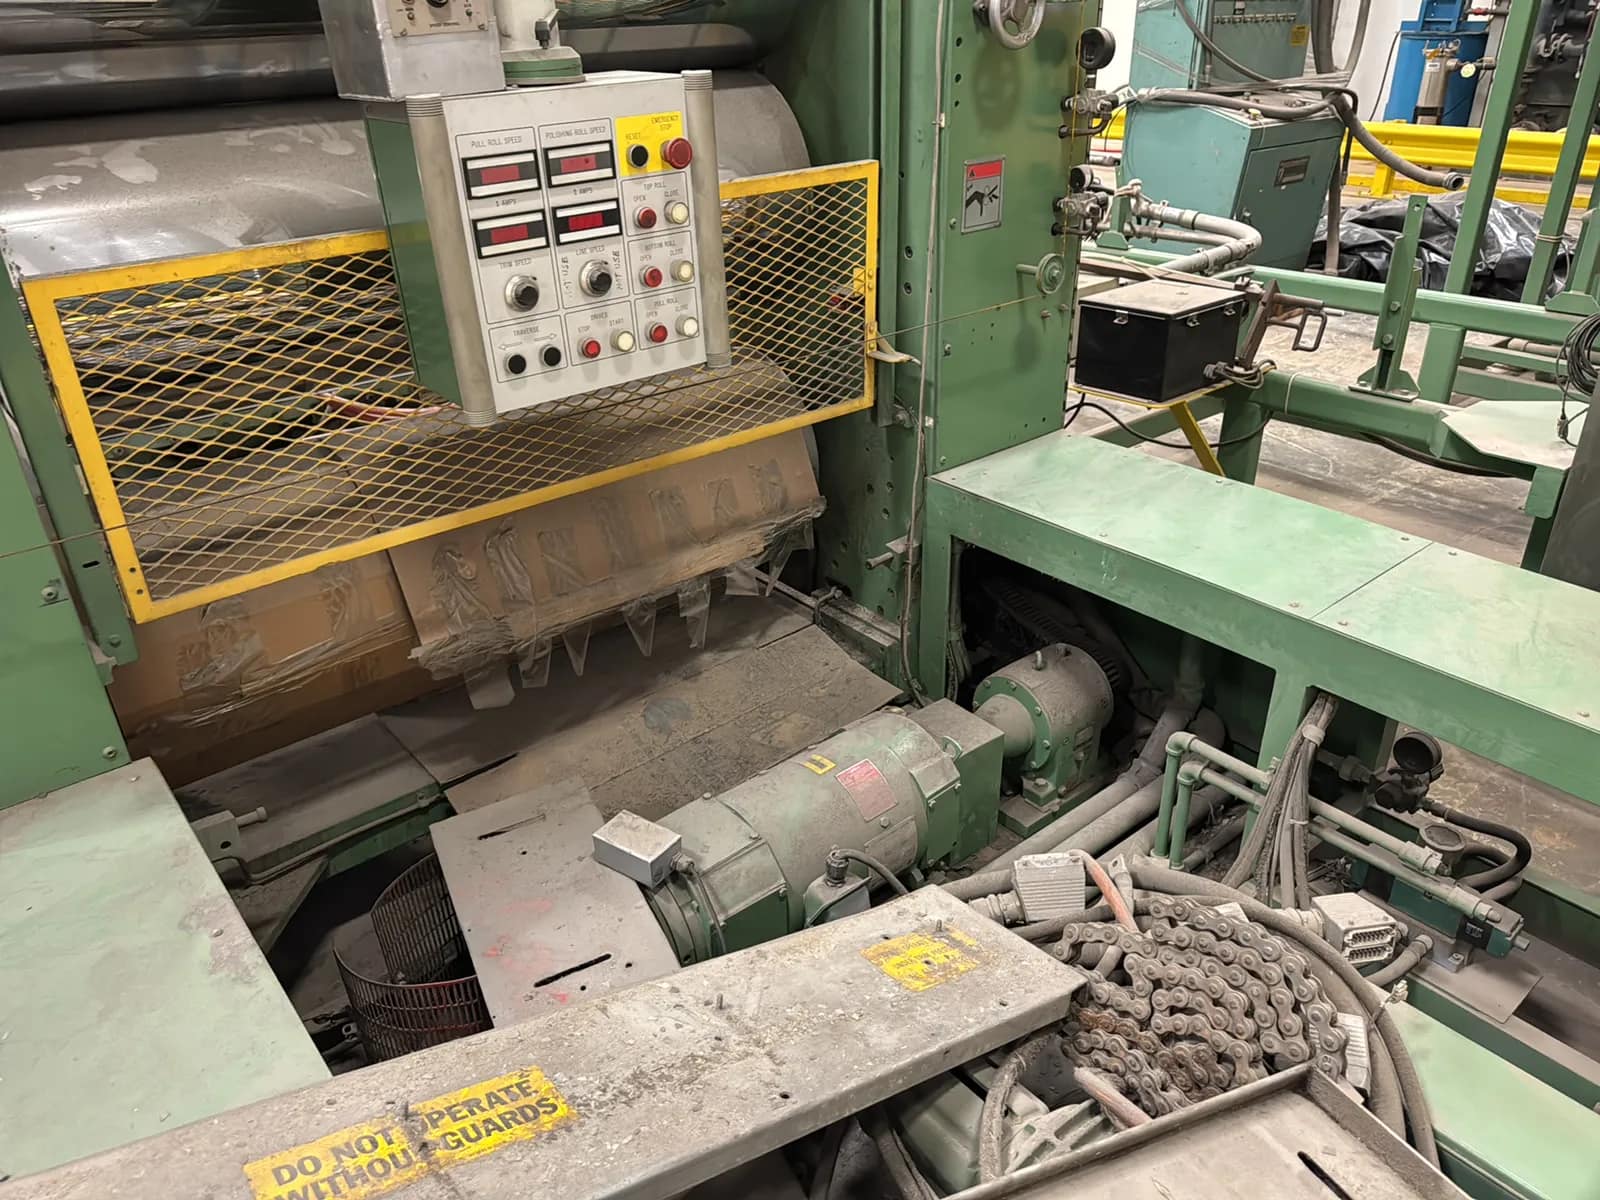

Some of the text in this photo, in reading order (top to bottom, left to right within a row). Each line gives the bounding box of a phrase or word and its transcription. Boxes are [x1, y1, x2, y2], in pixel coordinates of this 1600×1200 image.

[545, 125, 606, 139] POLISHING ROLL SPEED
[625, 132, 641, 141] RESET
[471, 135, 522, 148] PULL ROLL SPEED
[579, 187, 593, 195] AMPS
[643, 183, 653, 191] TOP
[501, 198, 517, 206] AMPS
[576, 245, 605, 256] LINE SPEED
[514, 257, 532, 267] SPEED
[609, 318, 624, 327] START
[513, 325, 540, 337] TRAVERSE
[577, 325, 591, 334] STOP
[440, 1097, 559, 1150] GUARDS
[271, 1155, 322, 1186] DO
[328, 1128, 396, 1166] NOT
